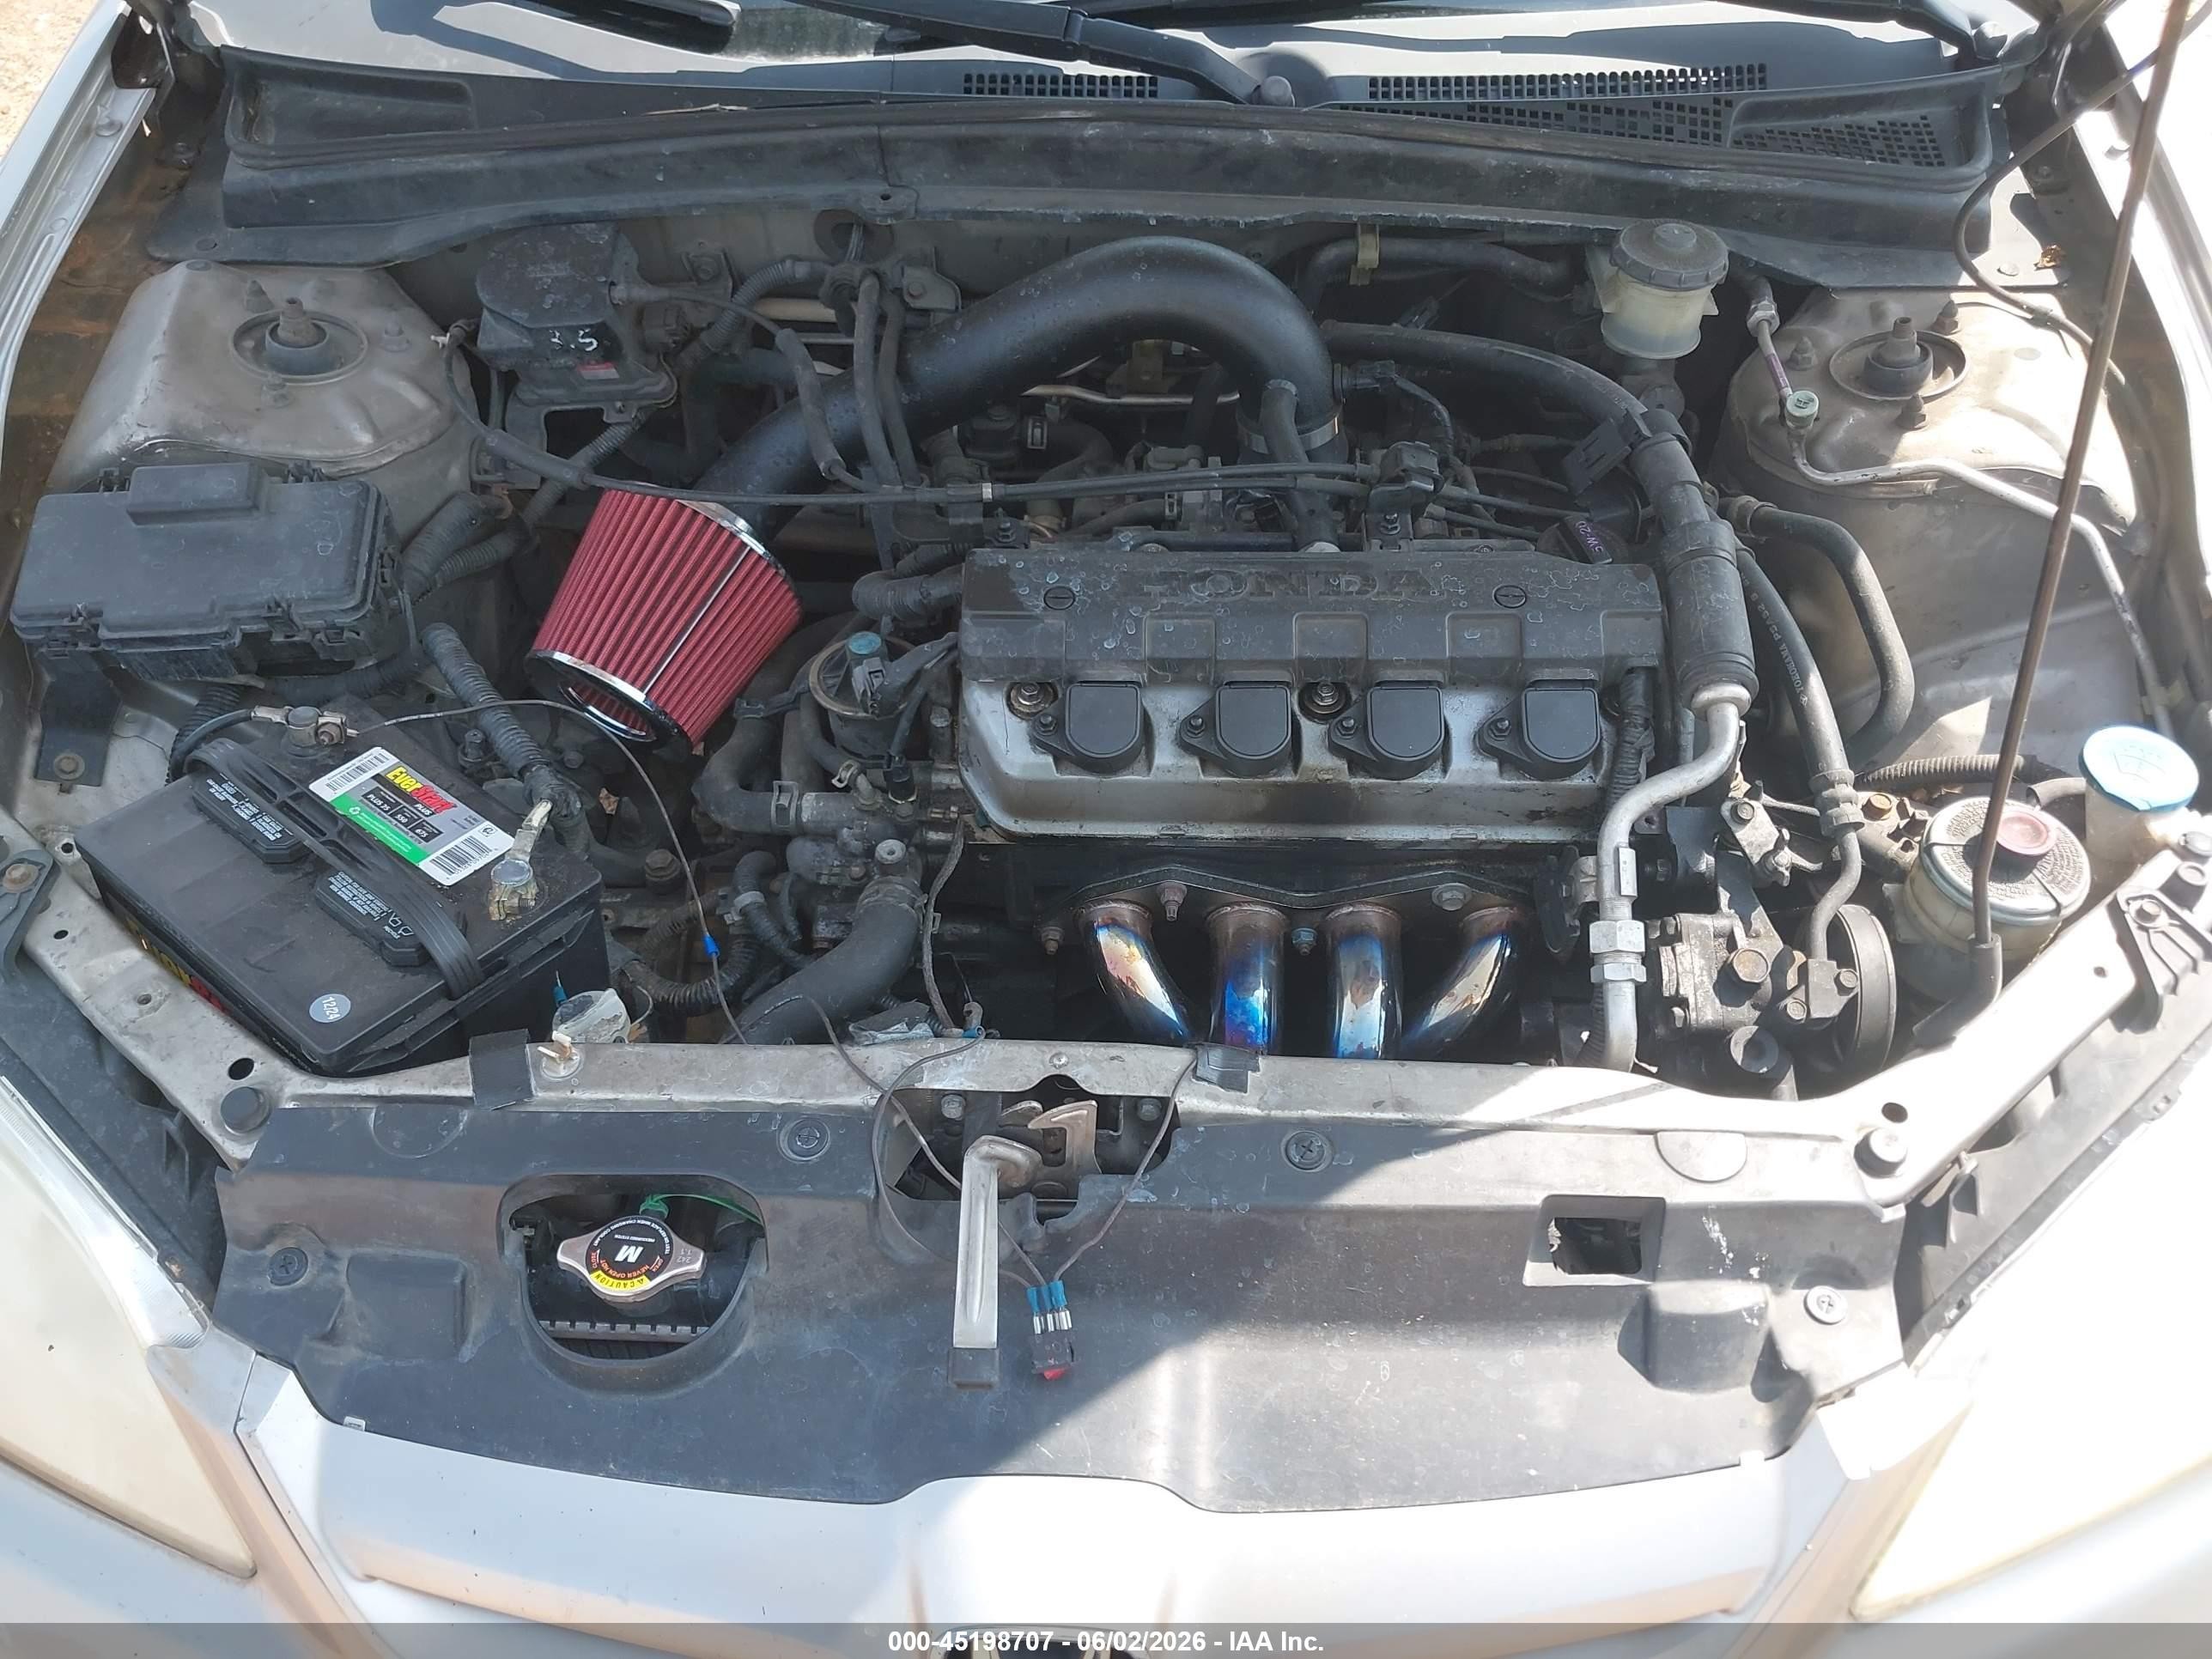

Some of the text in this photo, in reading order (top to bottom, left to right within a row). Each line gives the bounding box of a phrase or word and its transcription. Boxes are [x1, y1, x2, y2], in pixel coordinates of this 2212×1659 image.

[1130, 568, 1446, 599] HONDA
[386, 766, 457, 813] EverStart
[367, 793, 384, 806] PLUS
[414, 803, 434, 816] PLUS
[394, 814, 409, 823] 550
[414, 829, 428, 838] 675
[614, 1245, 644, 1263] M
[600, 1260, 649, 1279] NEVER OPEN HOT
[652, 1258, 664, 1273] OPEN
[594, 1273, 635, 1288] CAUTION
